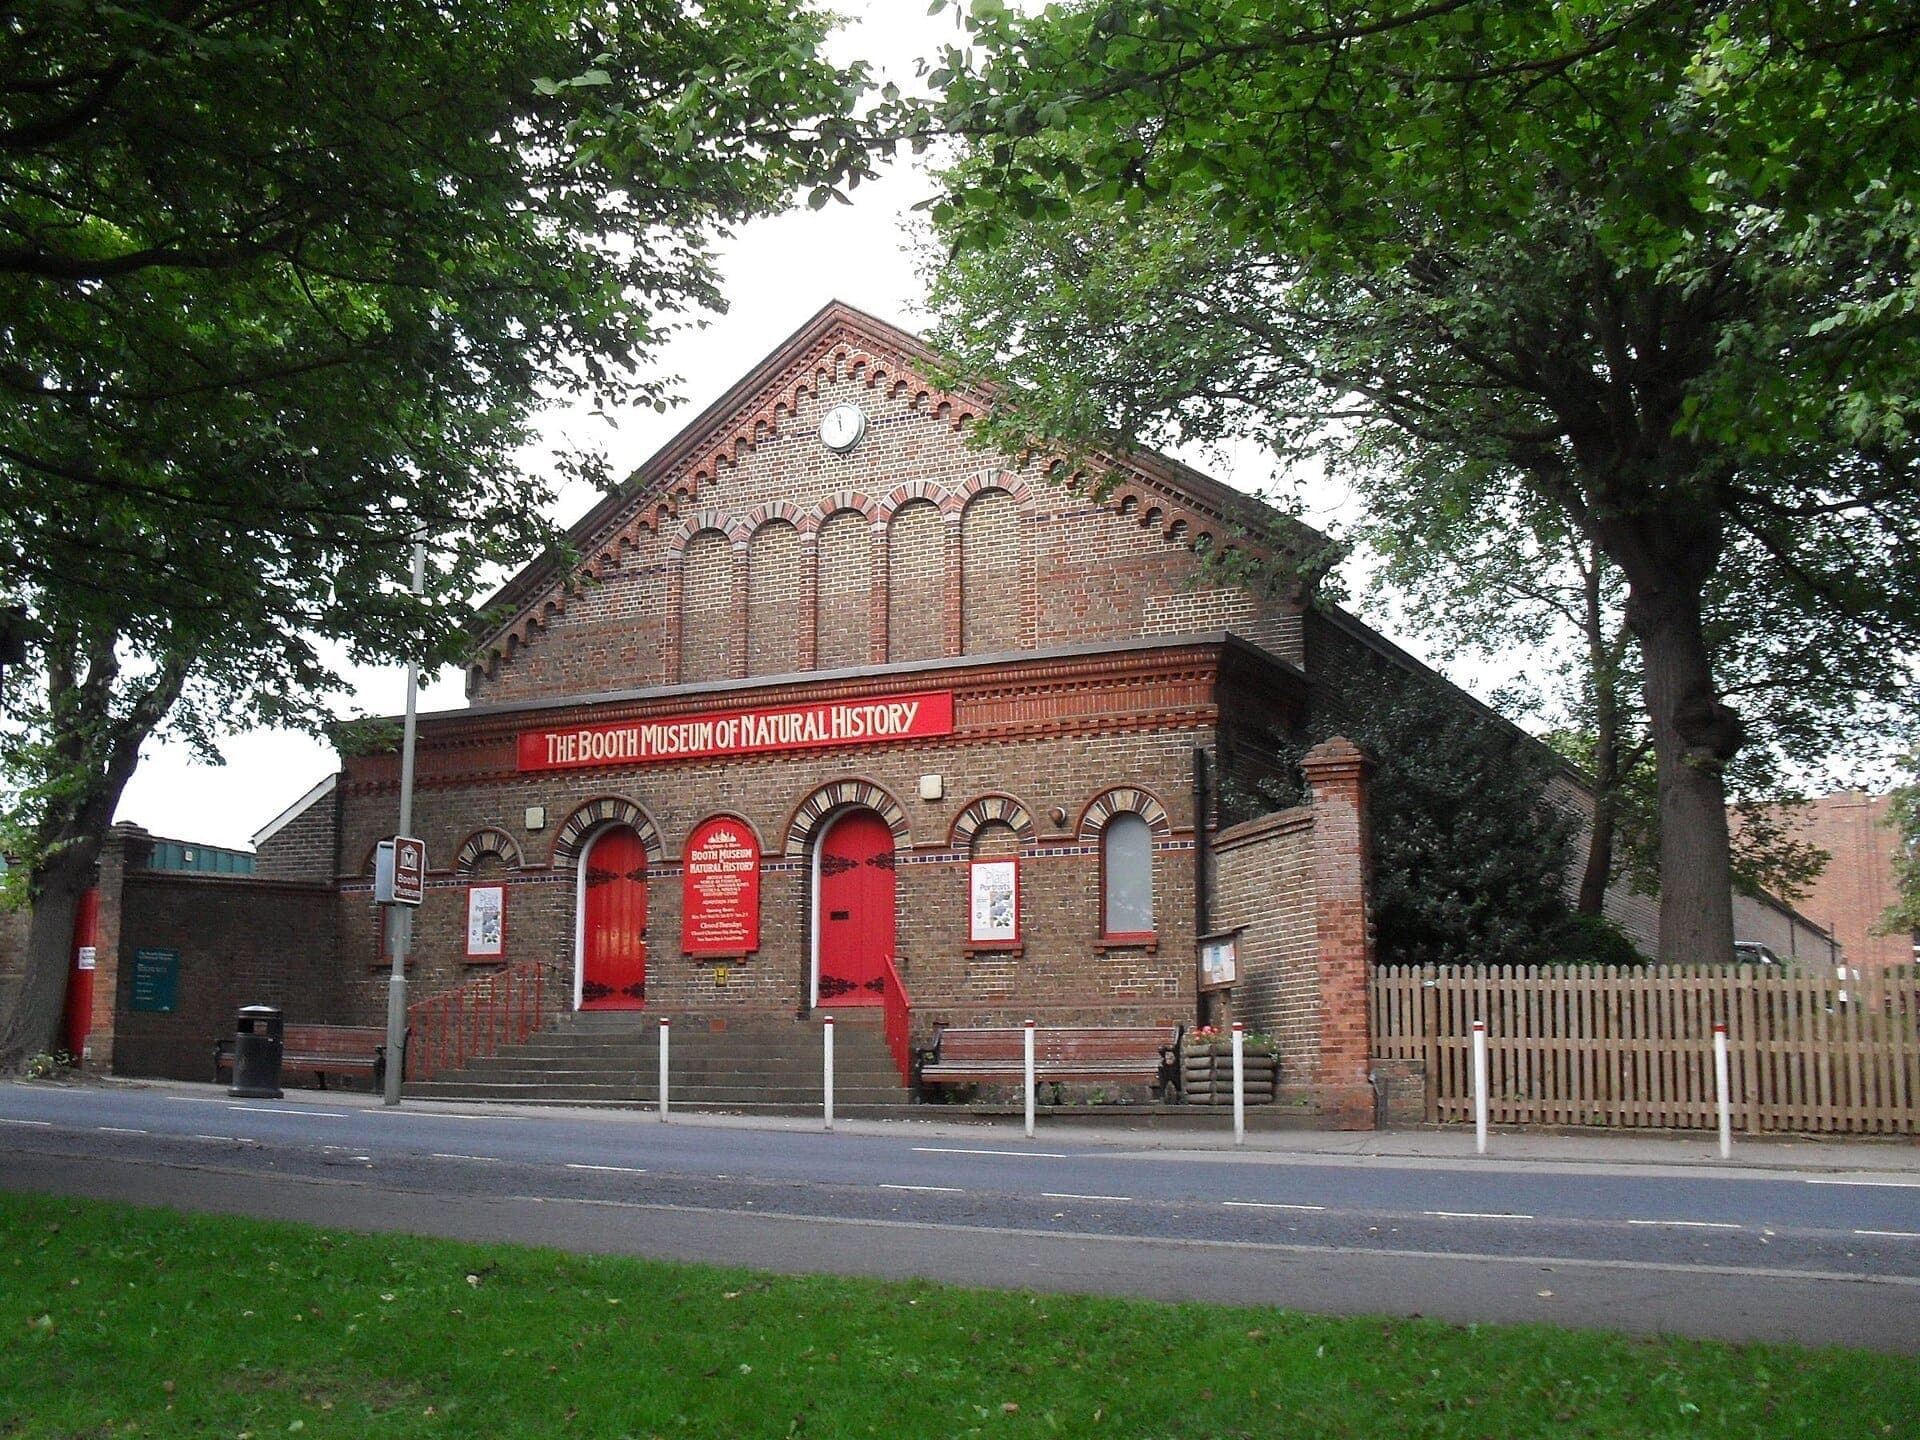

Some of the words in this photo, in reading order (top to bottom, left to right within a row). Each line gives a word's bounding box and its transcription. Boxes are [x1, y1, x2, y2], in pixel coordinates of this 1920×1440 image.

[545, 733, 576, 763] THE
[577, 729, 638, 761] BOOTH
[640, 723, 713, 755] MUSEUM
[715, 720, 739, 748] OF
[740, 711, 830, 745] NATURAL
[831, 702, 919, 739] HISTORY
[691, 850, 718, 861] BOOTH
[719, 849, 752, 860] MUSEUM
[690, 863, 722, 874] NATURAL
[722, 861, 754, 872] HISTORY
[397, 873, 419, 885] Booth
